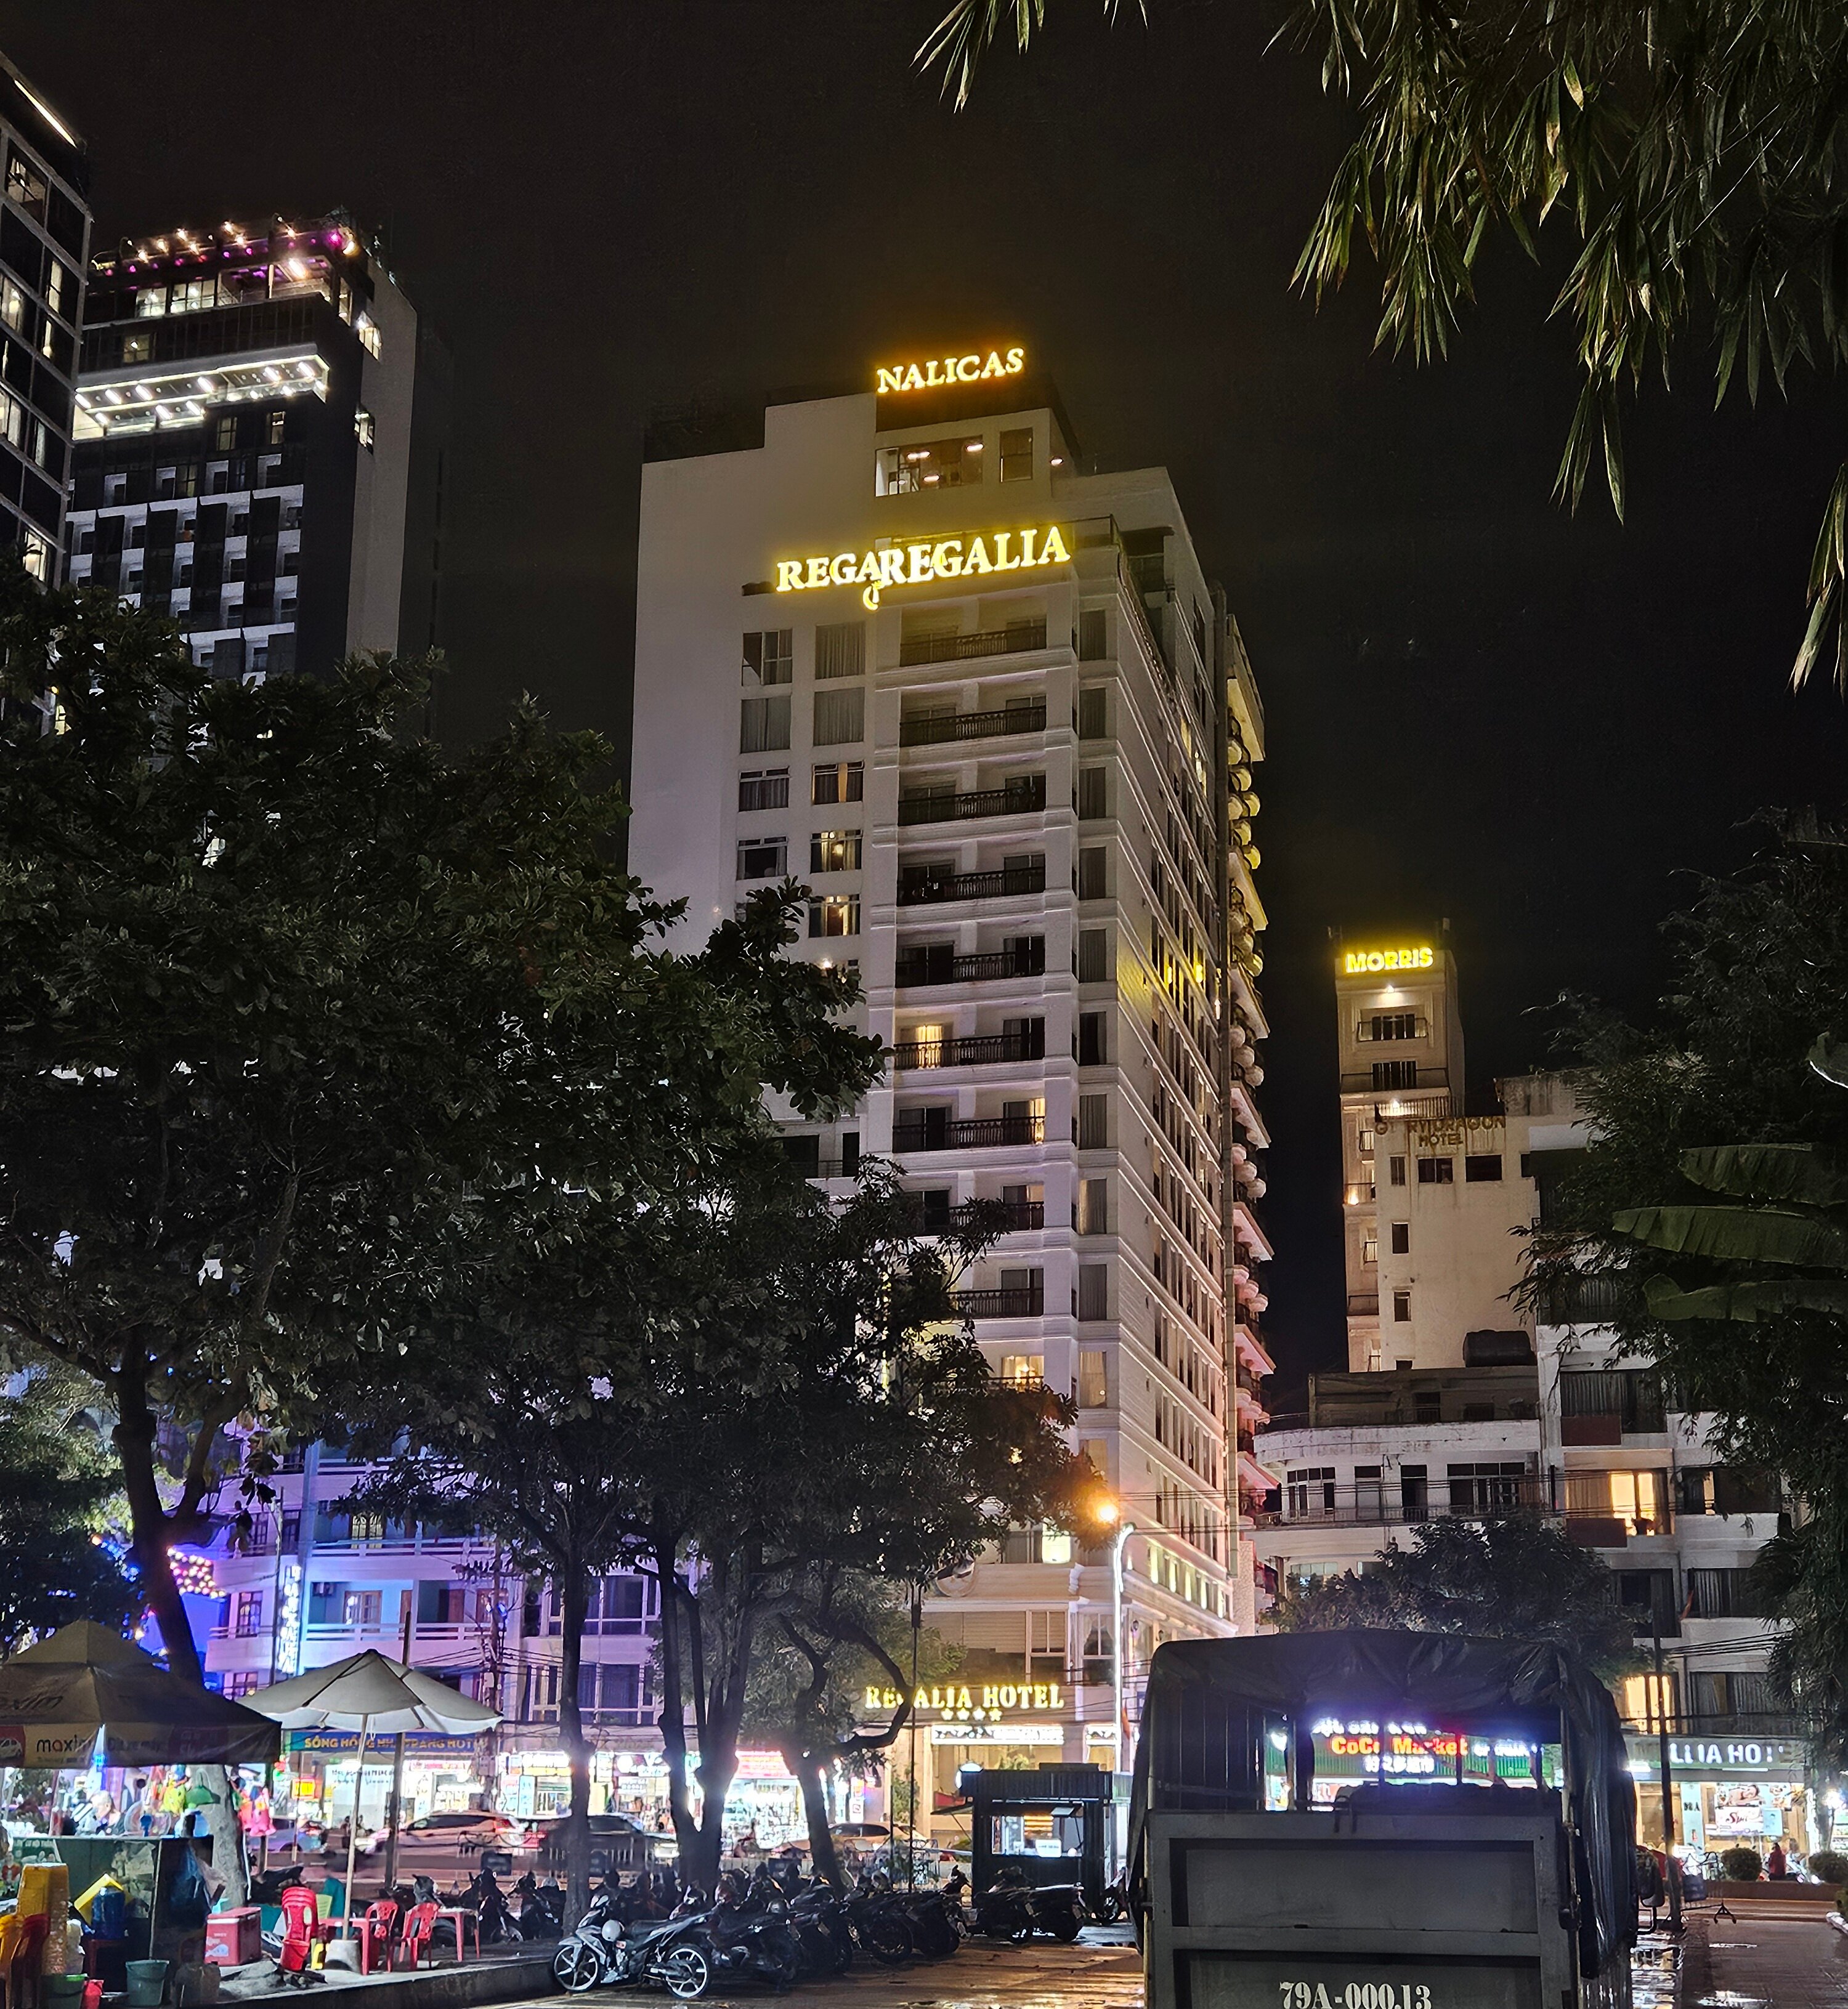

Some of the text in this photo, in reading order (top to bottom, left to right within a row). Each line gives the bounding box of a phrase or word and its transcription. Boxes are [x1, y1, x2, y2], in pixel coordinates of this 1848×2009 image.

[877, 347, 1026, 394] NALICAS
[877, 525, 1071, 588] REGALIA
[1345, 947, 1434, 974] MORRIS
[1419, 1132, 1464, 1147] HOTEL
[983, 1683, 1065, 1709] HOTEL
[305, 1734, 338, 1748] SÔNG
[377, 1737, 396, 1748] NH
[1279, 1981, 1432, 2009] 79A-000.13
